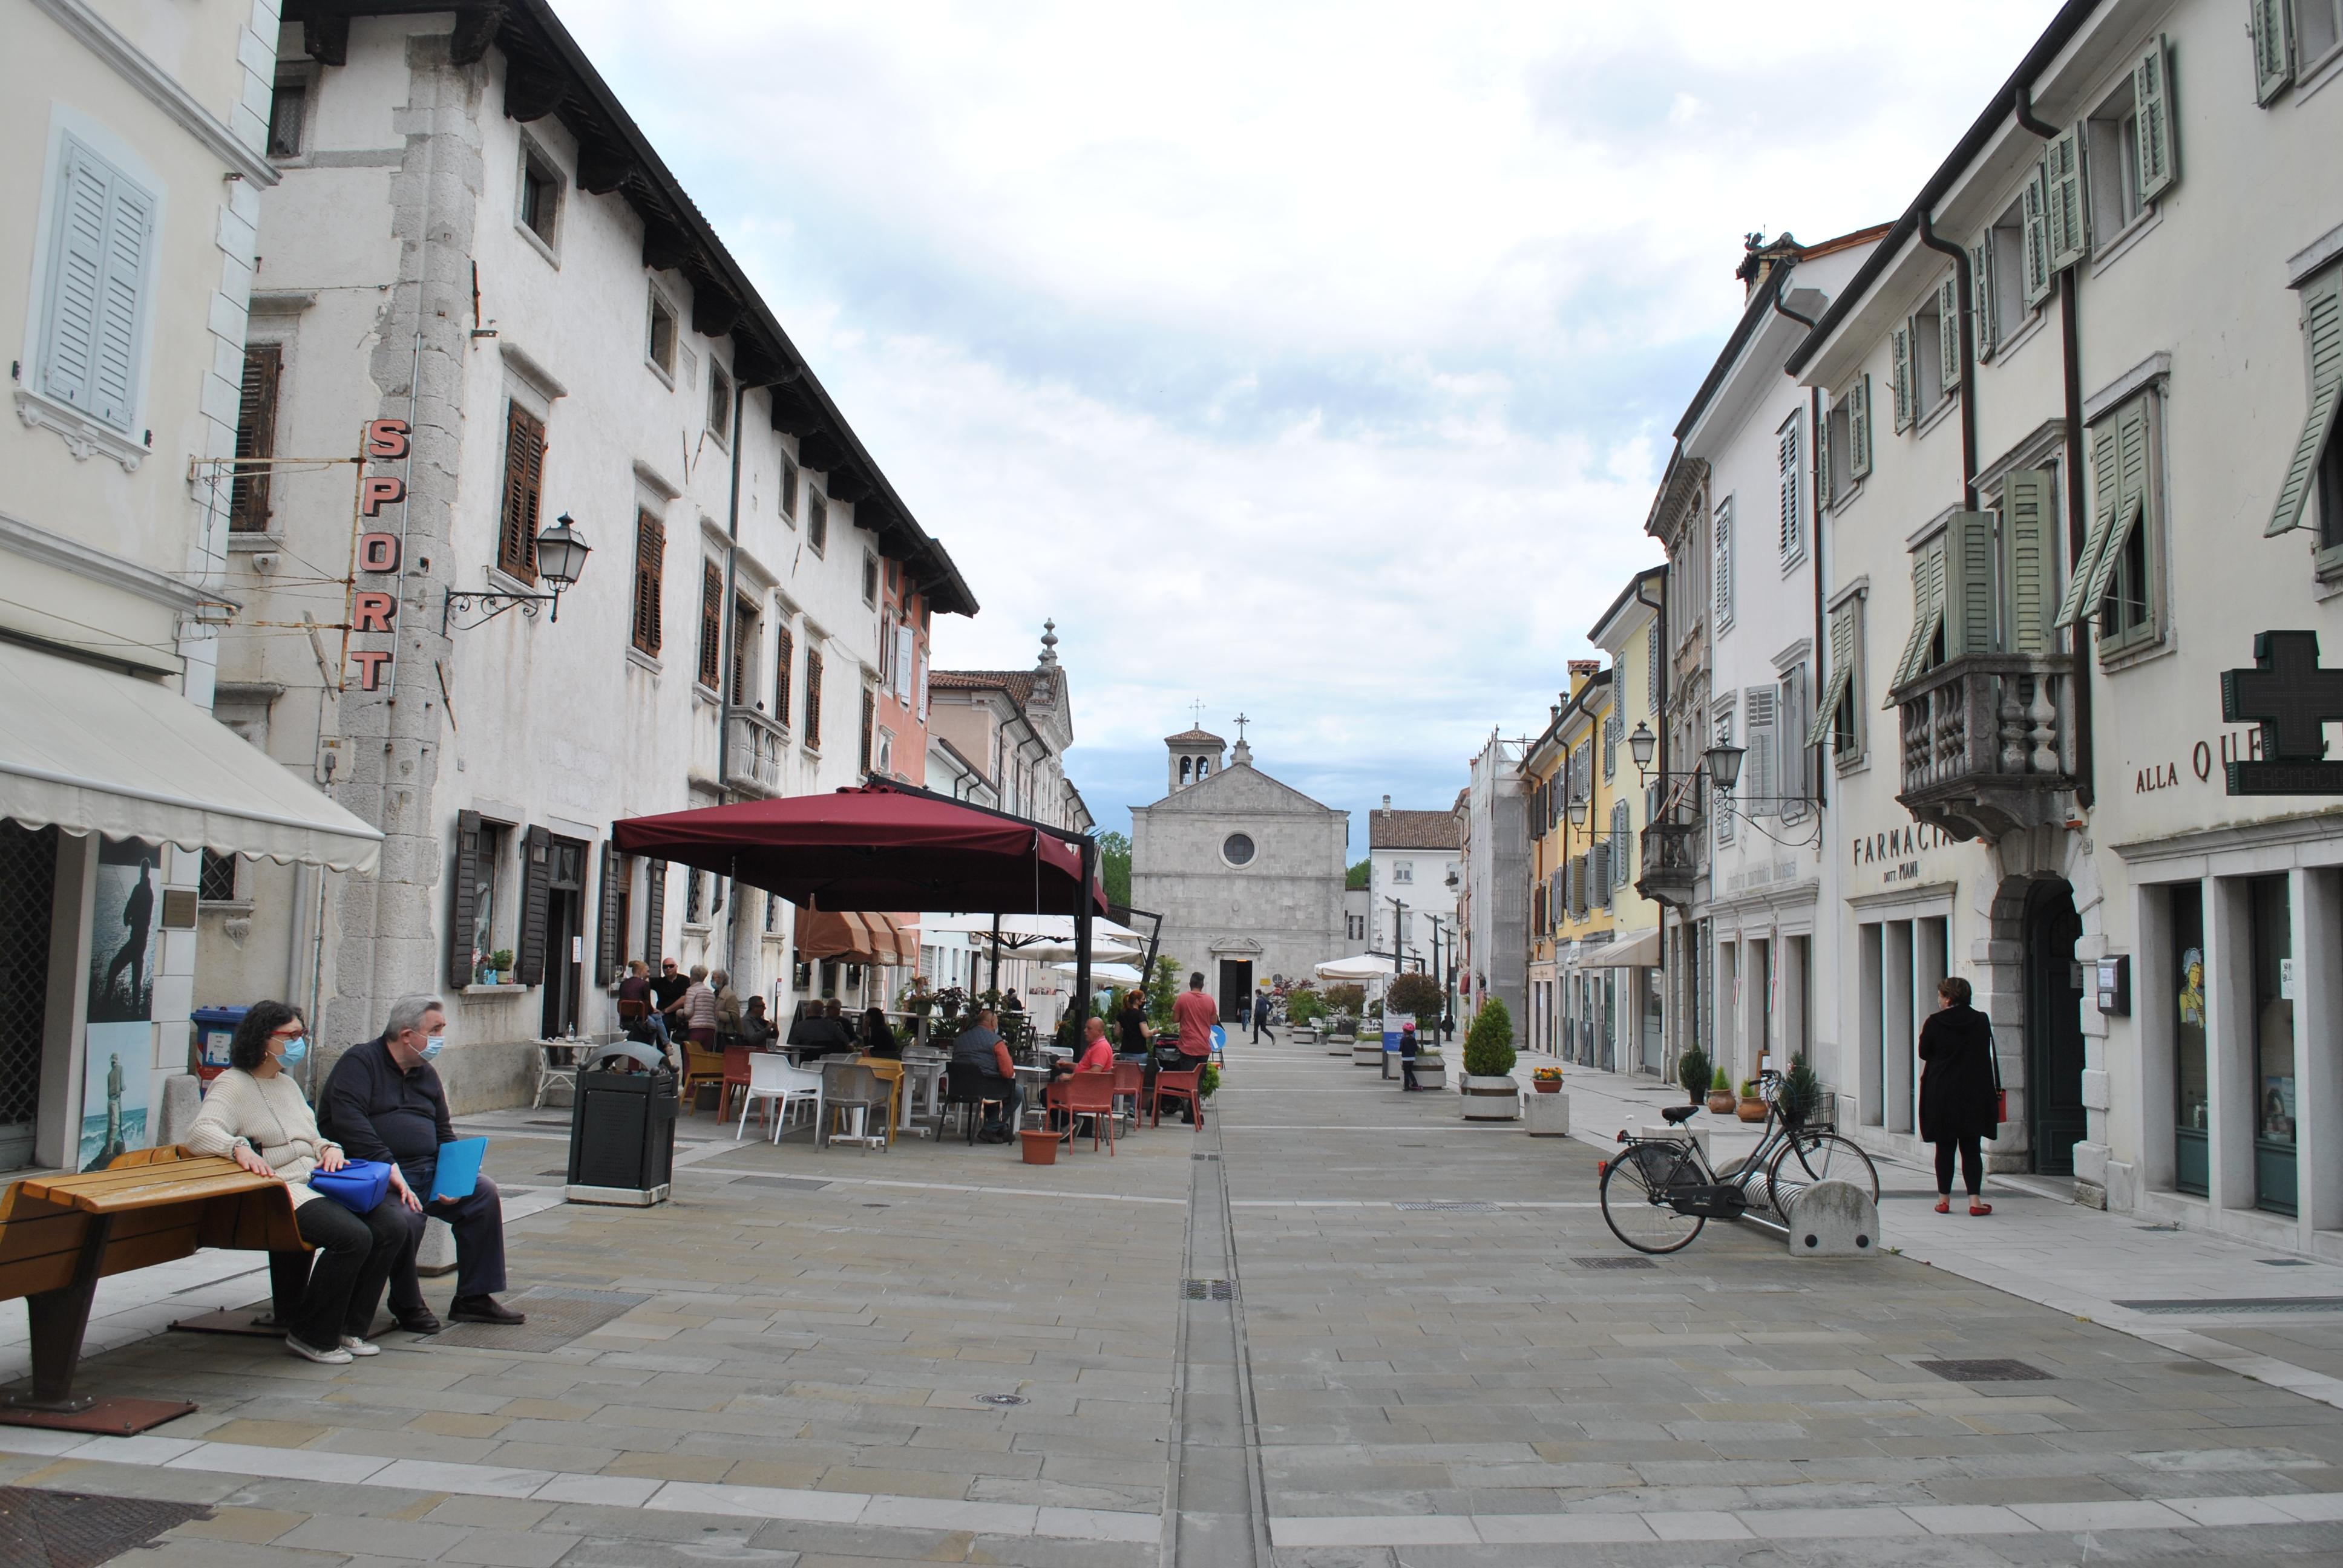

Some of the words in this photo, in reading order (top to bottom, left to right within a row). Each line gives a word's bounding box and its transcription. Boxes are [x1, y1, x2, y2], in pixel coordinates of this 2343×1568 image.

[350, 419, 412, 692] SPORT
[2135, 762, 2178, 794] ALLA
[2247, 768, 2343, 788] FARMACI
[1884, 871, 1897, 883] DOTT.
[1899, 861, 1918, 880] PIANI
